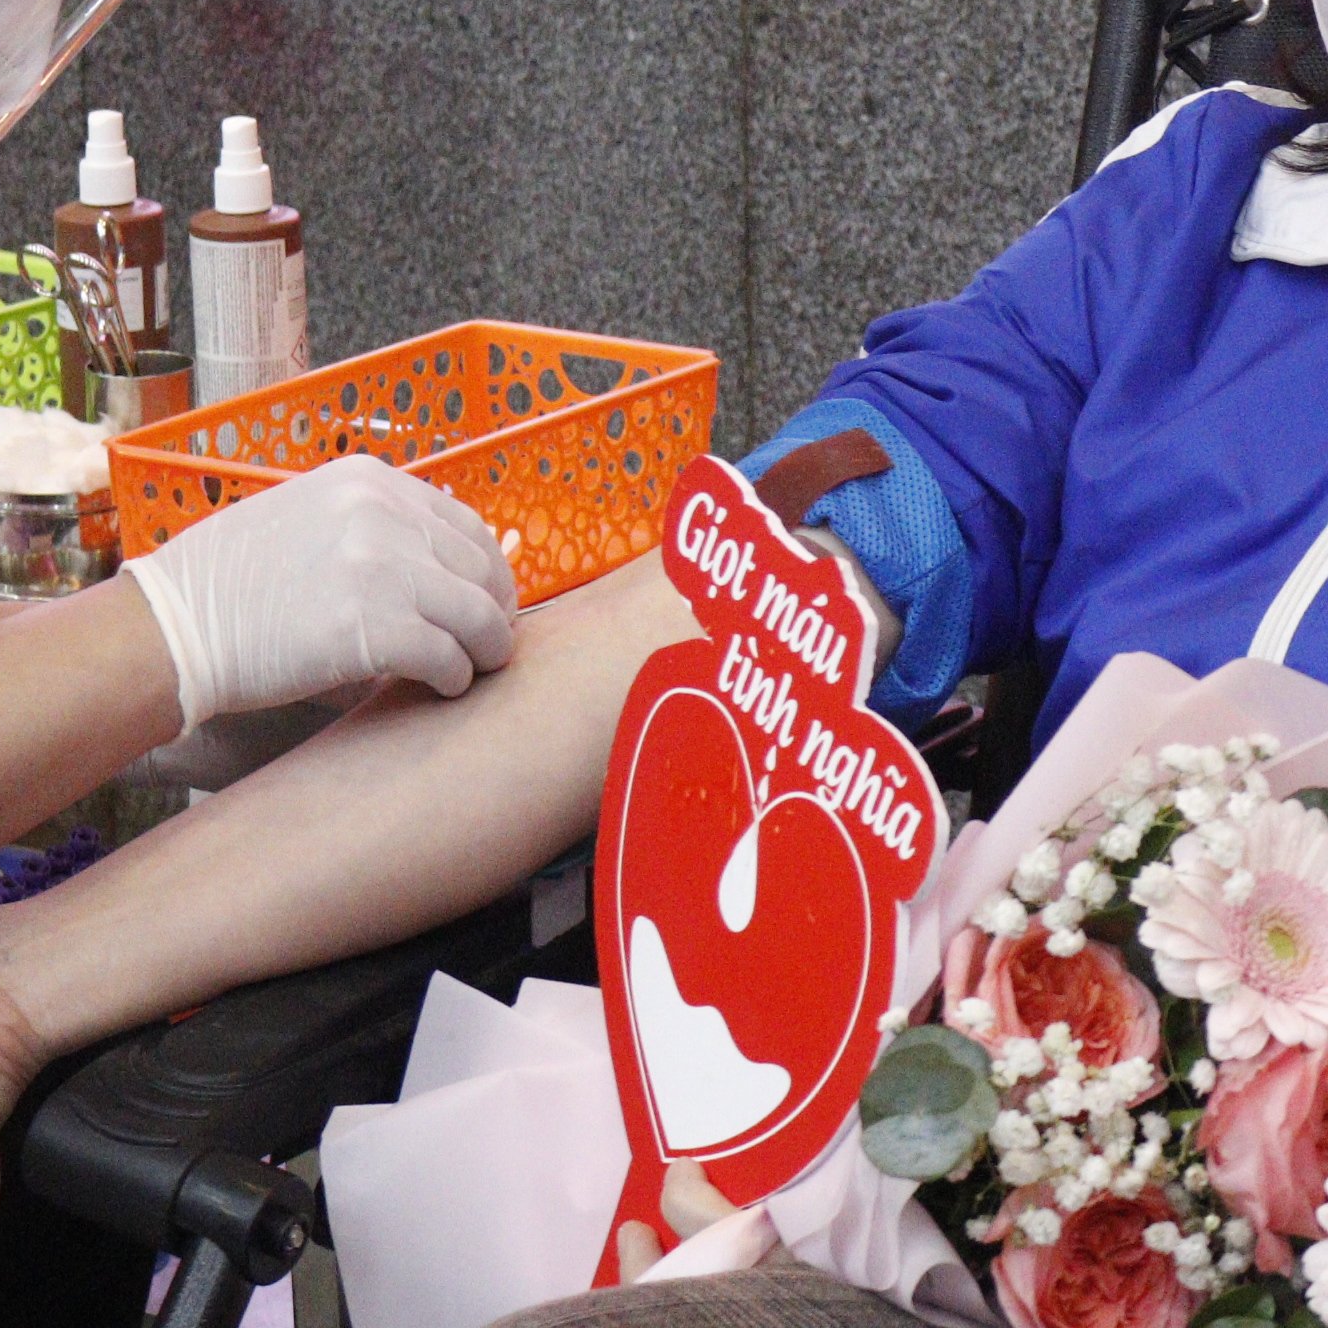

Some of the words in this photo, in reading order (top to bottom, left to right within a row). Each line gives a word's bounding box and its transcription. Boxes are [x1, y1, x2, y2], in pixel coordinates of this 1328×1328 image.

[676, 492, 756, 600] Giọt
[753, 574, 848, 685] máu
[717, 633, 798, 748] tình
[798, 719, 922, 860] nghĩa
